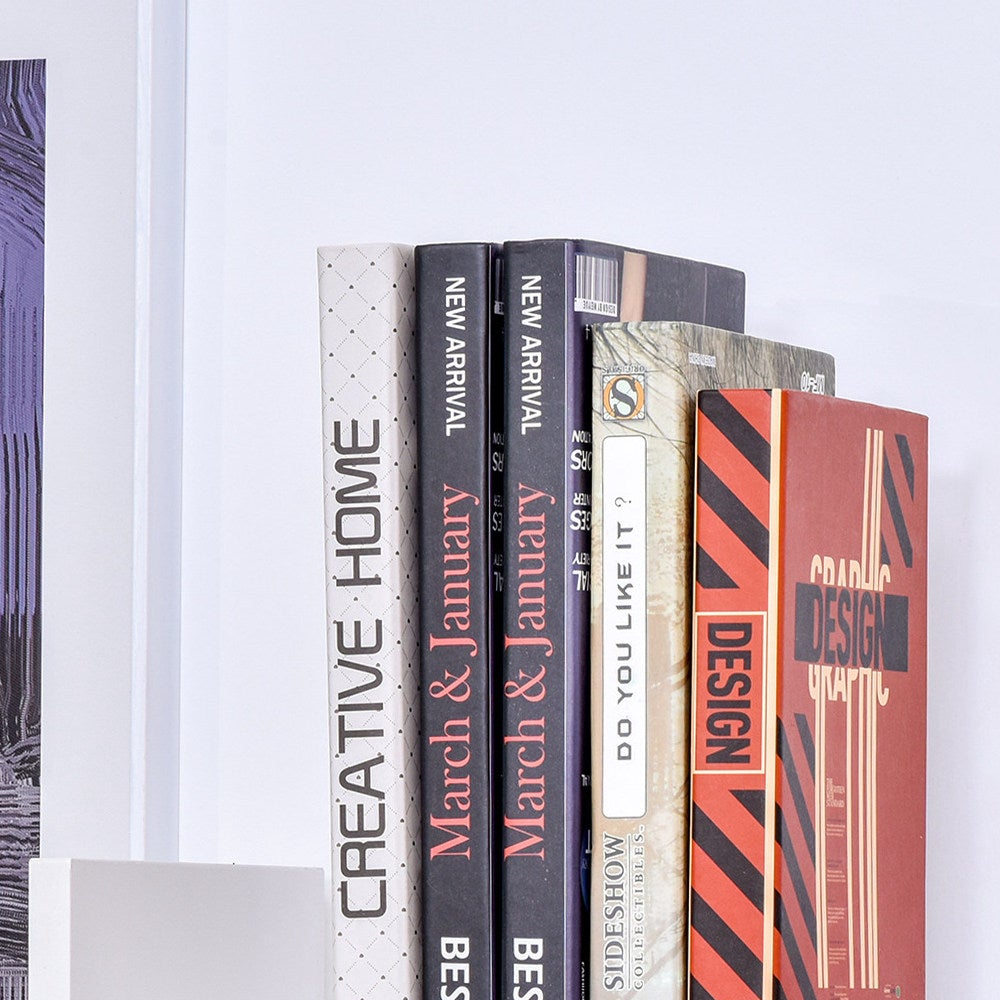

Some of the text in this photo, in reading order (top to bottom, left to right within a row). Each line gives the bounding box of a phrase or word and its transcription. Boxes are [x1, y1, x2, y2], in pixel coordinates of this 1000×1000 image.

[445, 277, 466, 437] NEW ARRIVAL
[521, 275, 542, 435] NEW ARRIVAL
[333, 419, 387, 919] CREATIVE HOME
[429, 483, 480, 861] March & January
[503, 483, 556, 861] March & January
[615, 496, 633, 761] DO YOU LIKE IT ?
[706, 623, 752, 765] DESIGN
[794, 582, 909, 672] DESIGN
[603, 832, 626, 992] SIDESHOW
